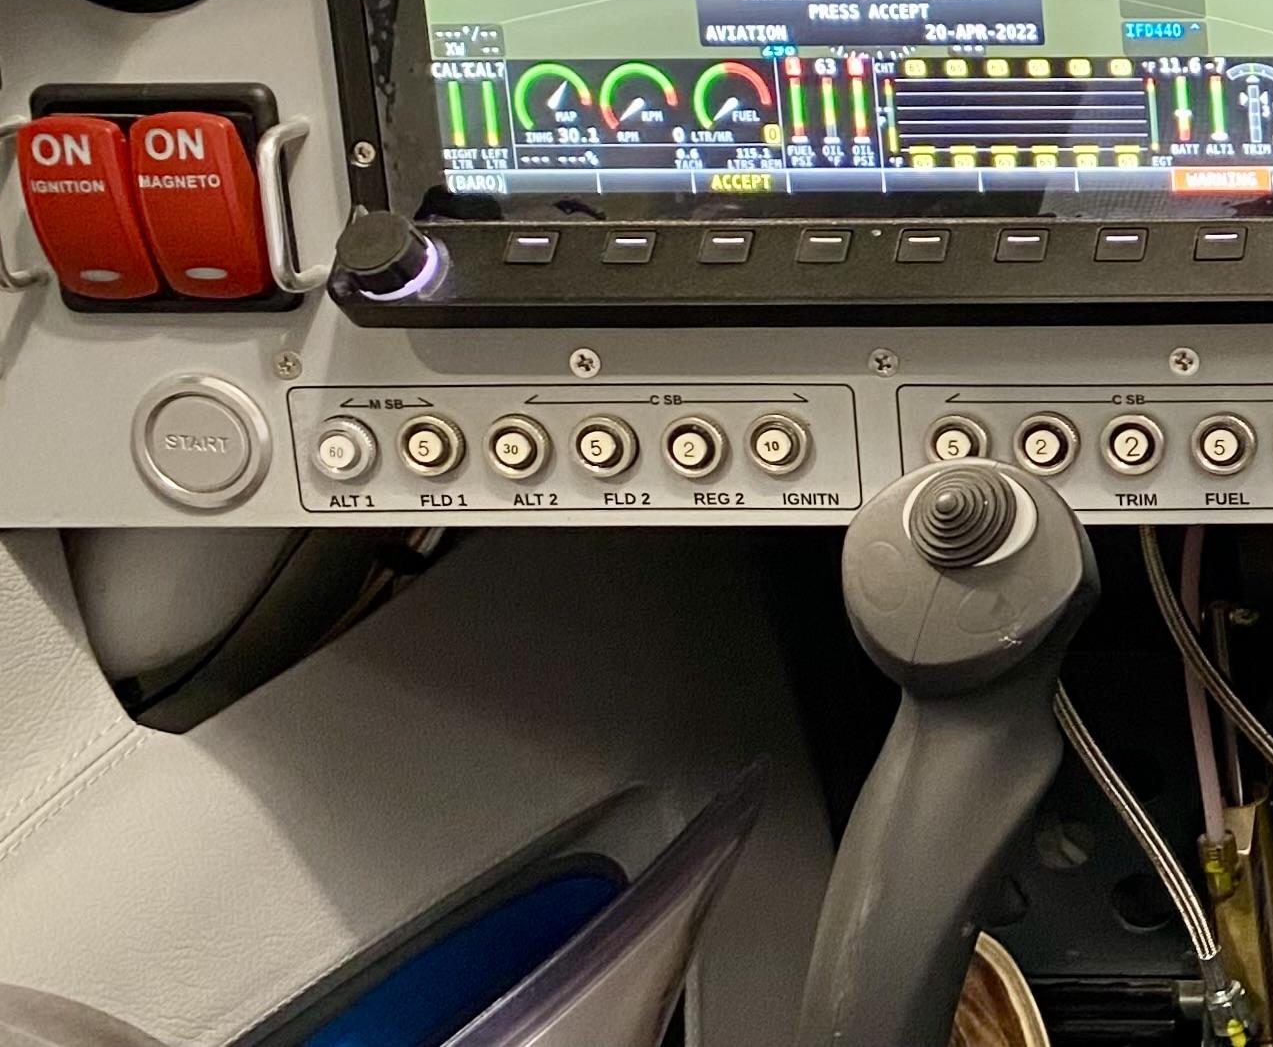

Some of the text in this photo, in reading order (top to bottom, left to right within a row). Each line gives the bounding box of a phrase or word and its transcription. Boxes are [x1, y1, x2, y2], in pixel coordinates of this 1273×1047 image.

[808, 4, 929, 19] PRESS ACCEPT
[706, 24, 1038, 41] AVIATION 20-APR-2022
[1126, 23, 1181, 38] IFD440
[31, 134, 92, 167] ON
[145, 127, 205, 160] ON
[31, 179, 105, 194] IGNITION
[139, 173, 221, 188] MAGNETO
[711, 175, 770, 189] ACCEPT
[165, 435, 228, 452] START
[330, 495, 375, 508] ALT 1
[513, 493, 558, 506] ALT 2
[604, 493, 650, 505] FLD 2
[694, 493, 745, 505] REG 2
[783, 493, 839, 505] IGNITN
[1116, 493, 1158, 506] TRIM
[1205, 493, 1249, 505] FUEL
